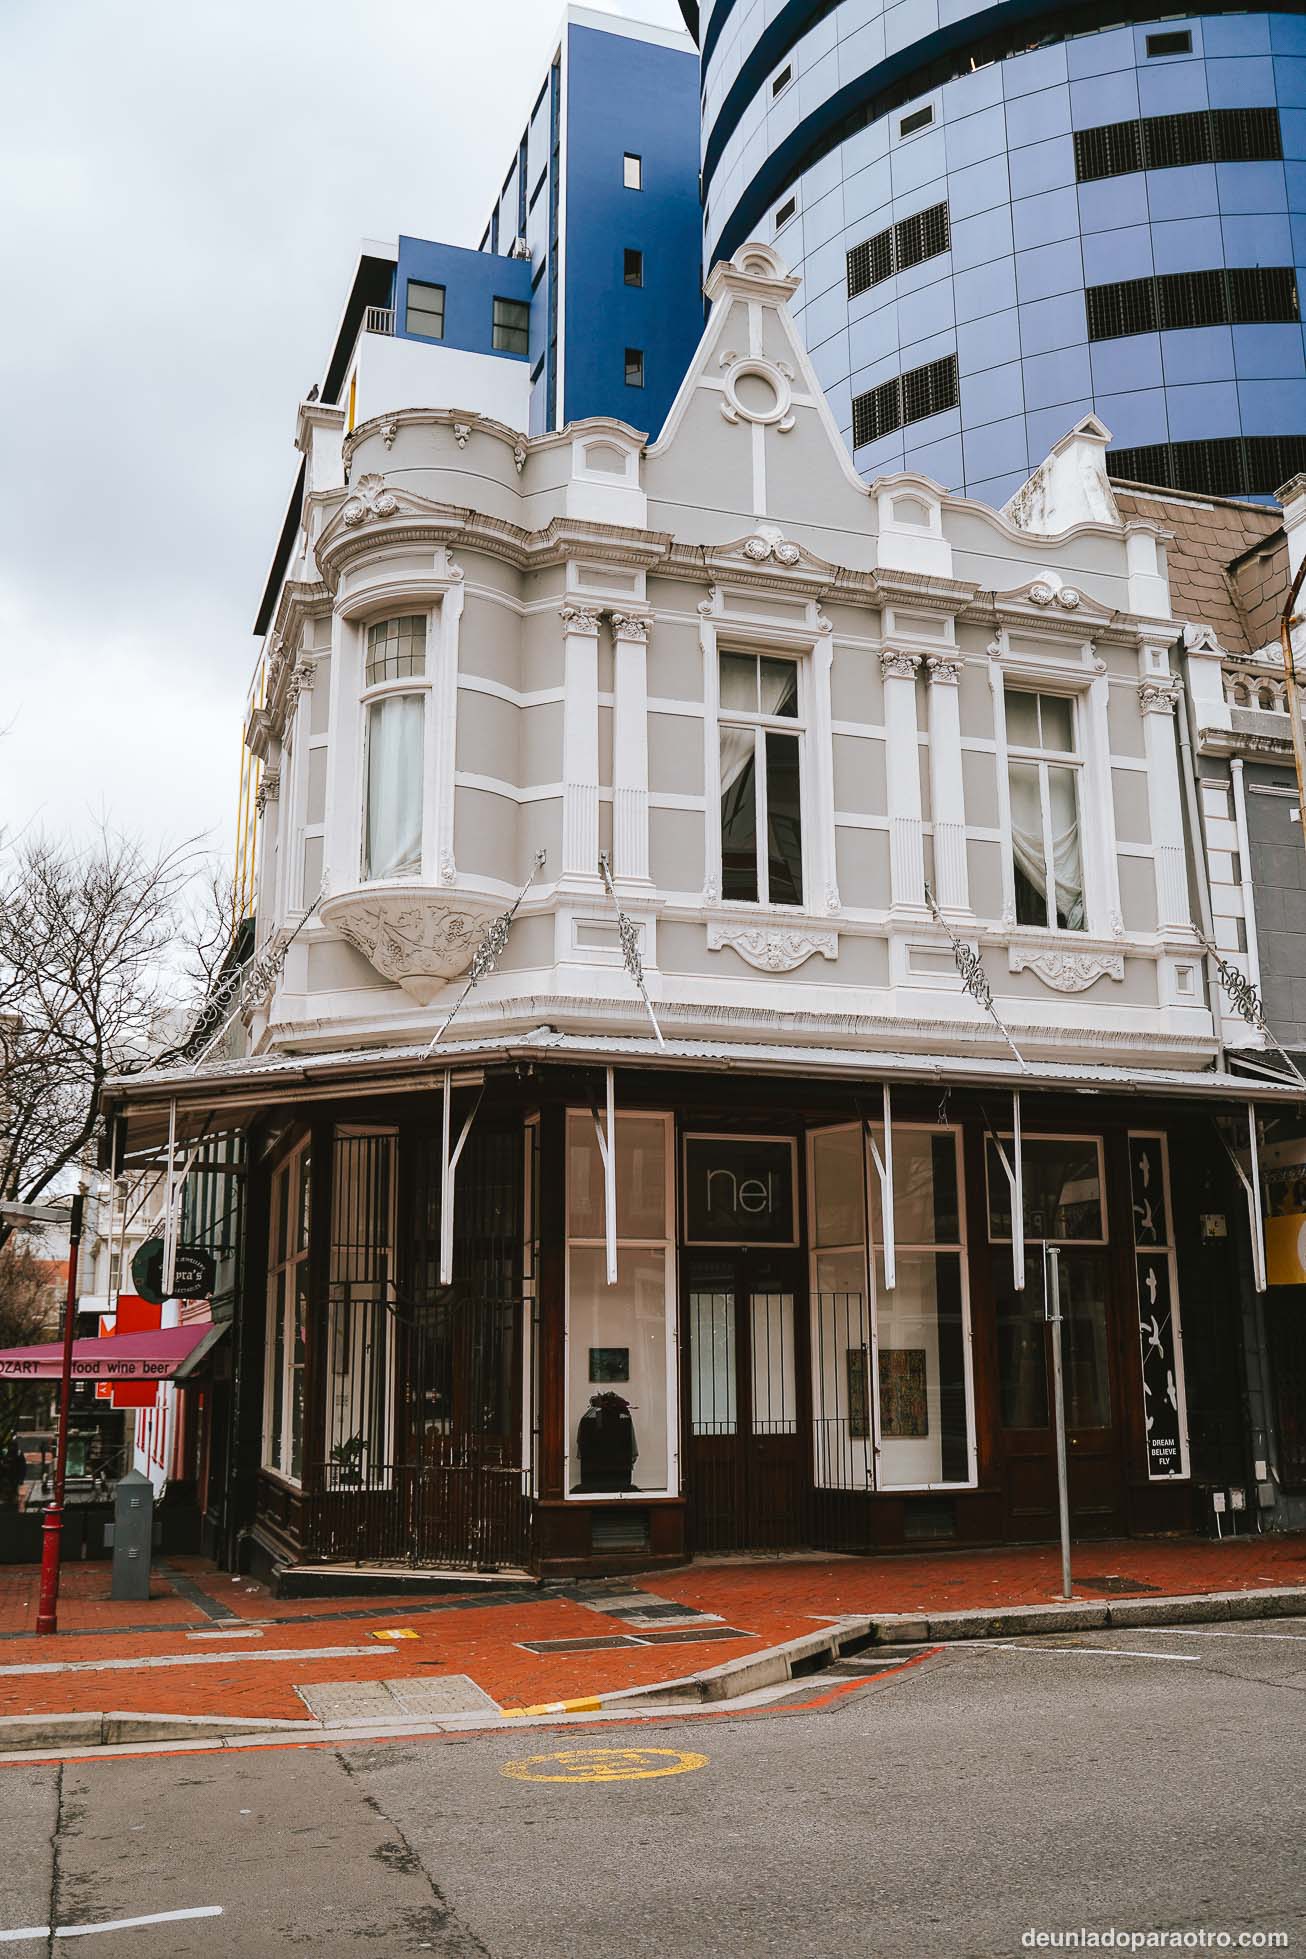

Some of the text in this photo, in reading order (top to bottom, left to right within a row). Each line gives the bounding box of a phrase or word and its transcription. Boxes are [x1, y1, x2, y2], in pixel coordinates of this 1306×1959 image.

[706, 1169, 772, 1213] nel
[175, 1269, 203, 1282] yra's
[72, 1360, 100, 1373] food
[107, 1360, 136, 1373] wine
[143, 1360, 169, 1373] beer
[1152, 1439, 1175, 1447] DREAM
[1151, 1448, 1177, 1456] BELIEVE
[1159, 1457, 1170, 1465] FLY
